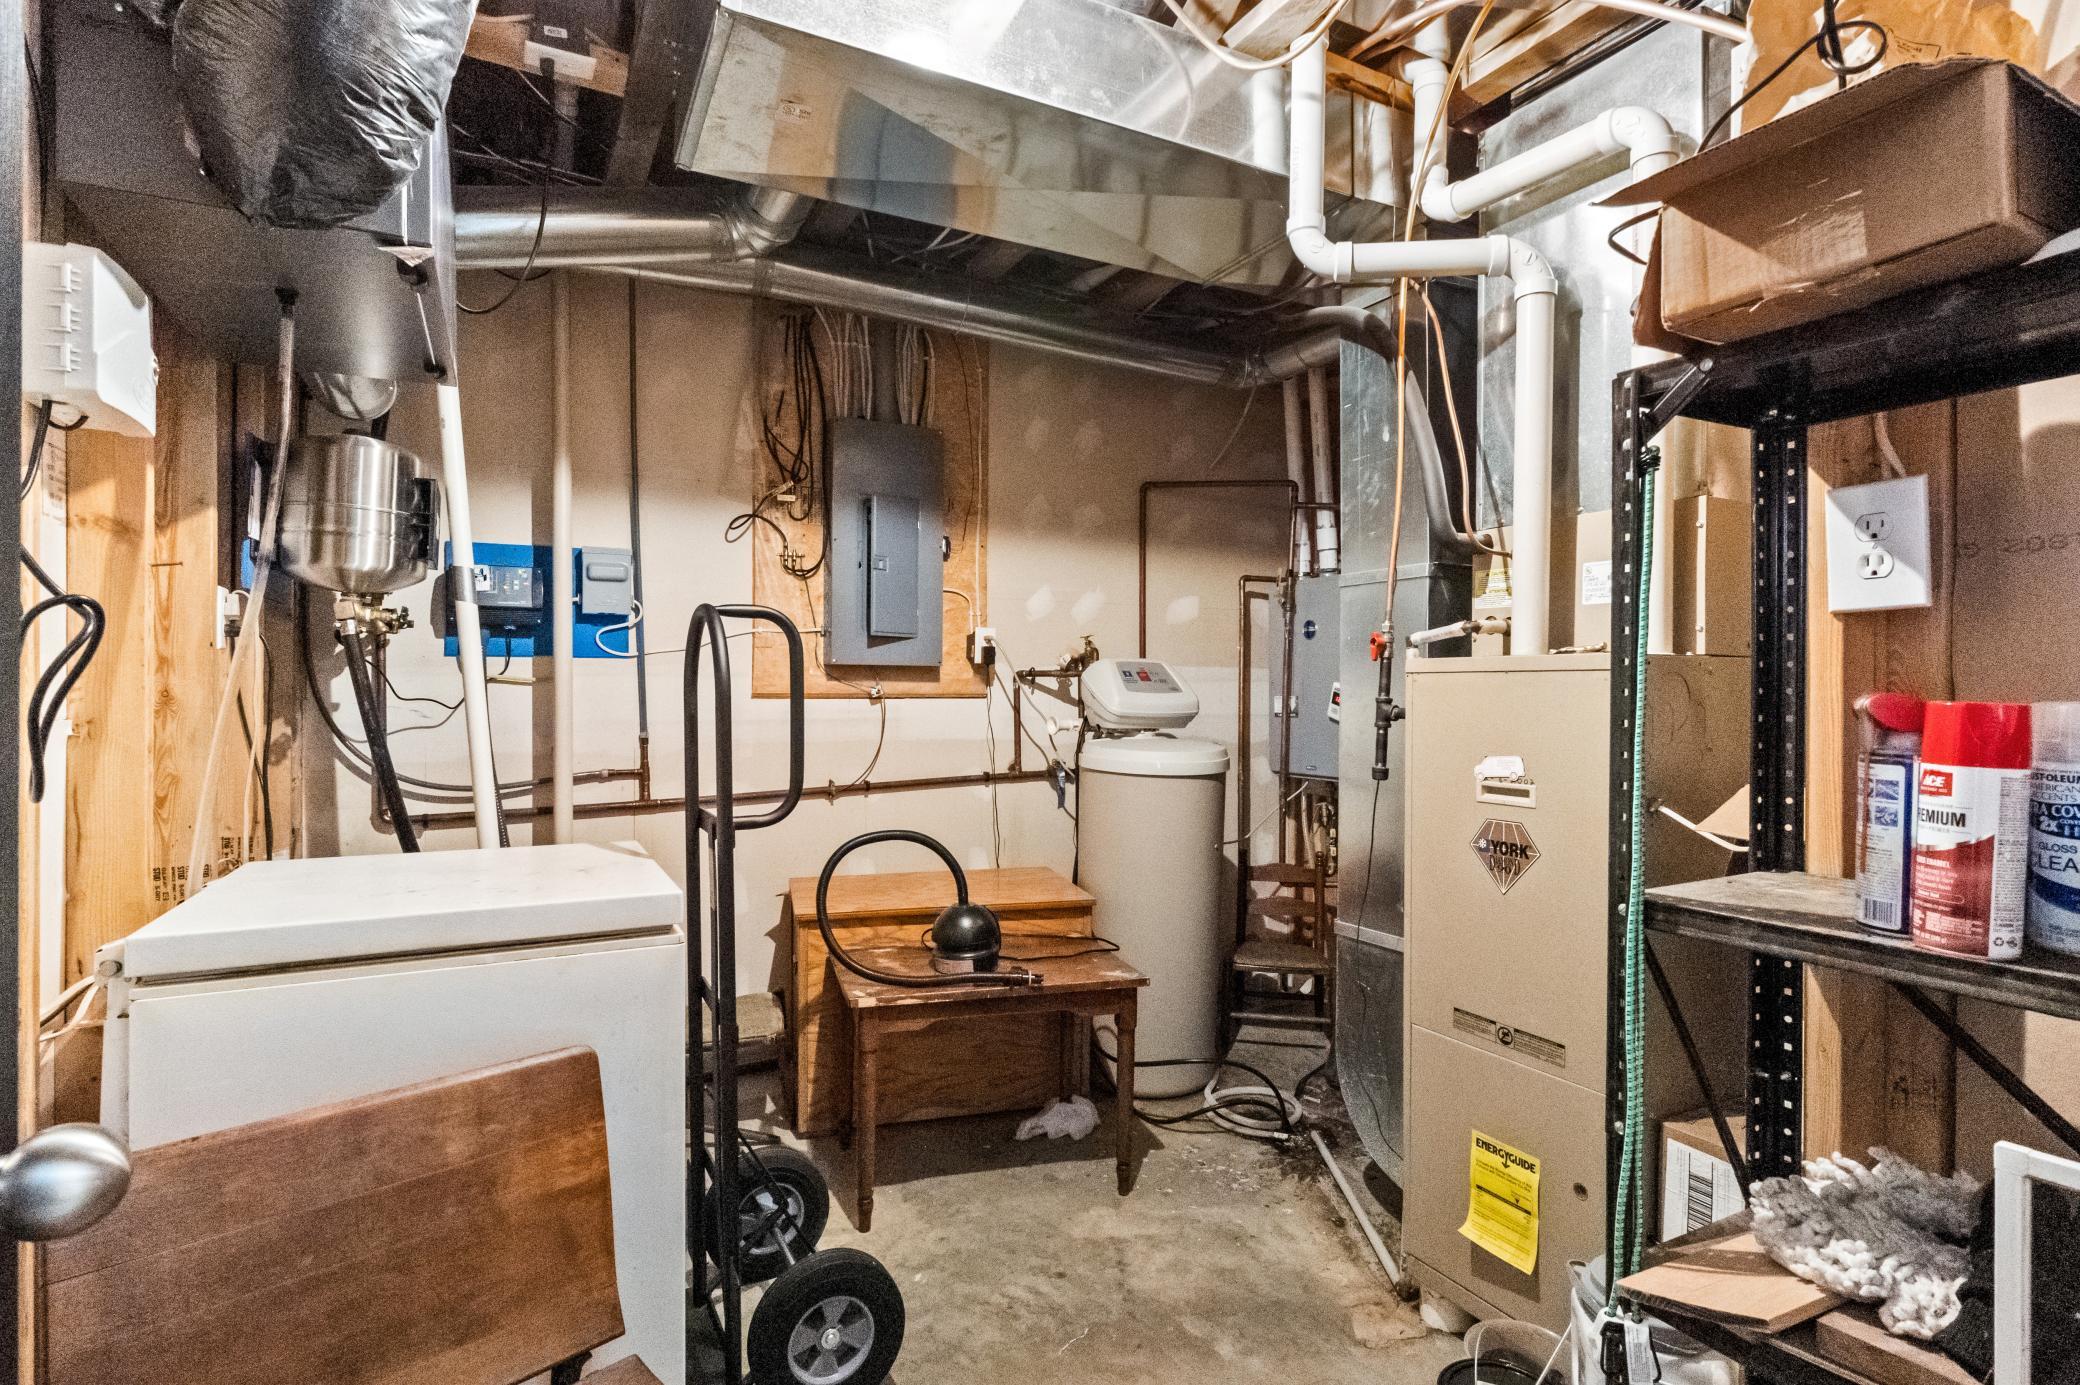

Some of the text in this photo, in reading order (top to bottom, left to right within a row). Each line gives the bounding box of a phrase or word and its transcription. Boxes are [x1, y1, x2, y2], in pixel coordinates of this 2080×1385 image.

[1923, 774, 1946, 787] ACE
[2030, 772, 2080, 784] UST-OLEU
[2051, 804, 2080, 818] COV
[1490, 839, 1530, 860] YORK
[2038, 841, 2078, 855] GLOSS
[2034, 854, 2080, 873] LEA
[153, 867, 161, 882] STUD
[177, 866, 185, 880] STUD
[1475, 1137, 1537, 1175] ENERGYGUIDE
